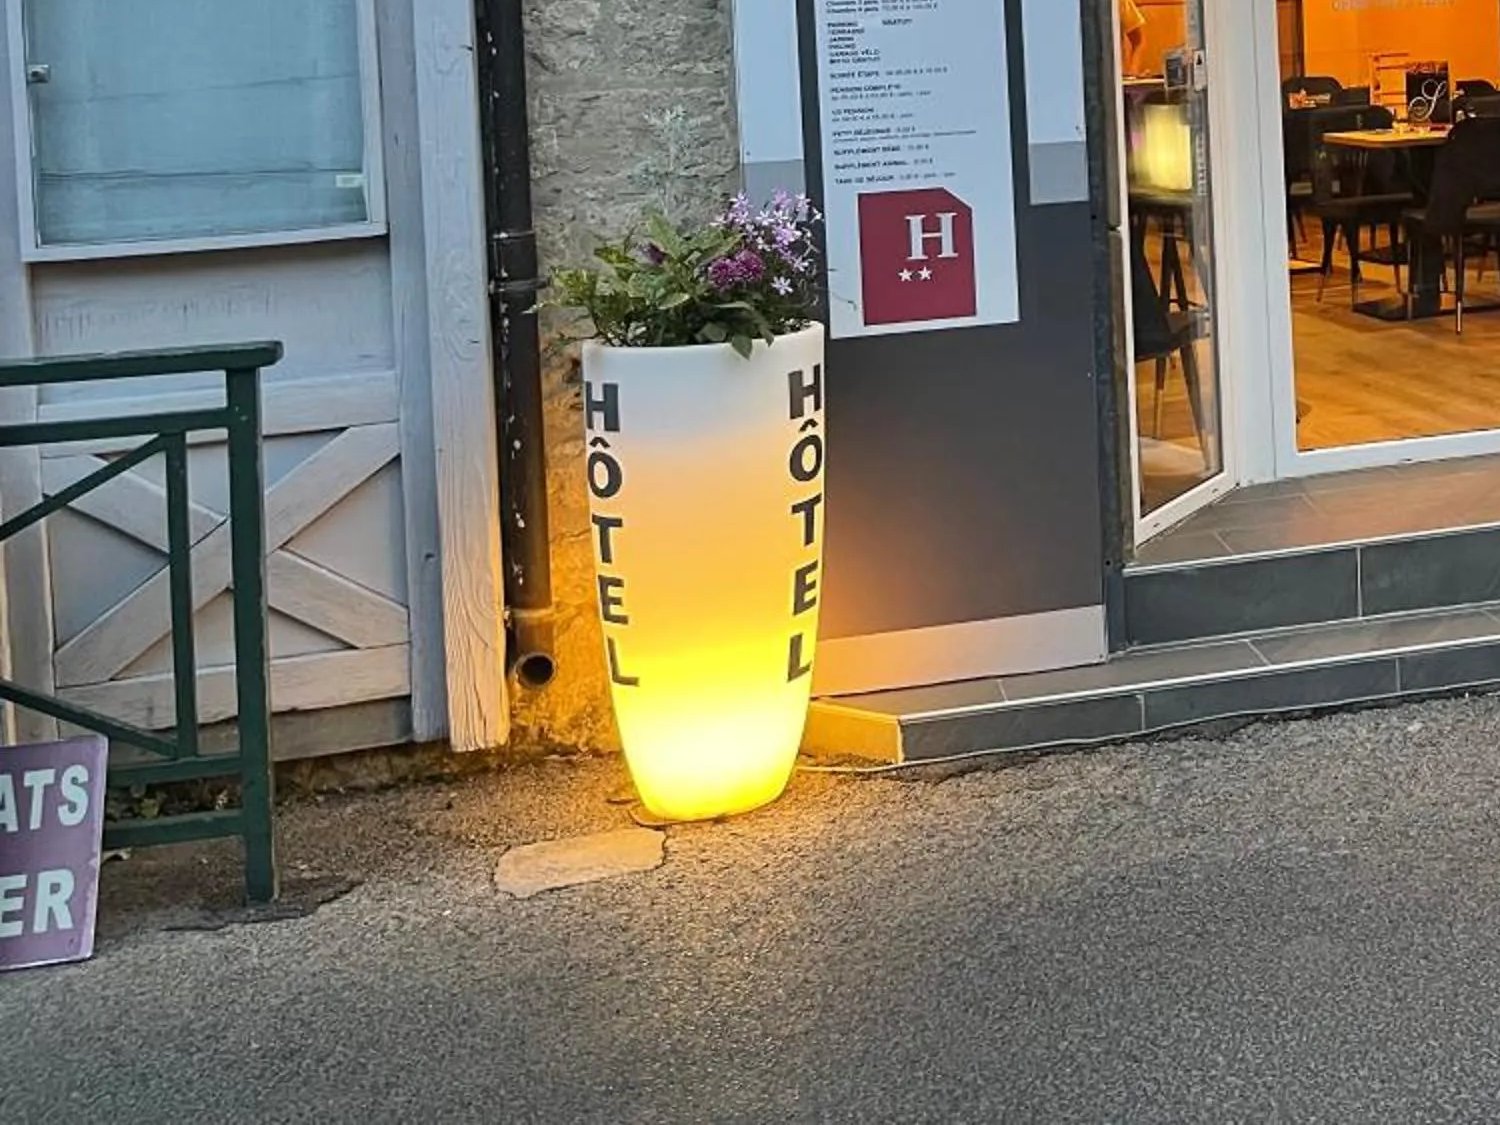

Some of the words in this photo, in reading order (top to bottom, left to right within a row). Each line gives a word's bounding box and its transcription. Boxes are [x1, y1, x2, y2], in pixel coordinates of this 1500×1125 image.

[905, 212, 958, 260] H
[585, 380, 639, 687] HÔTEL
[786, 363, 823, 682] HÔTEL
